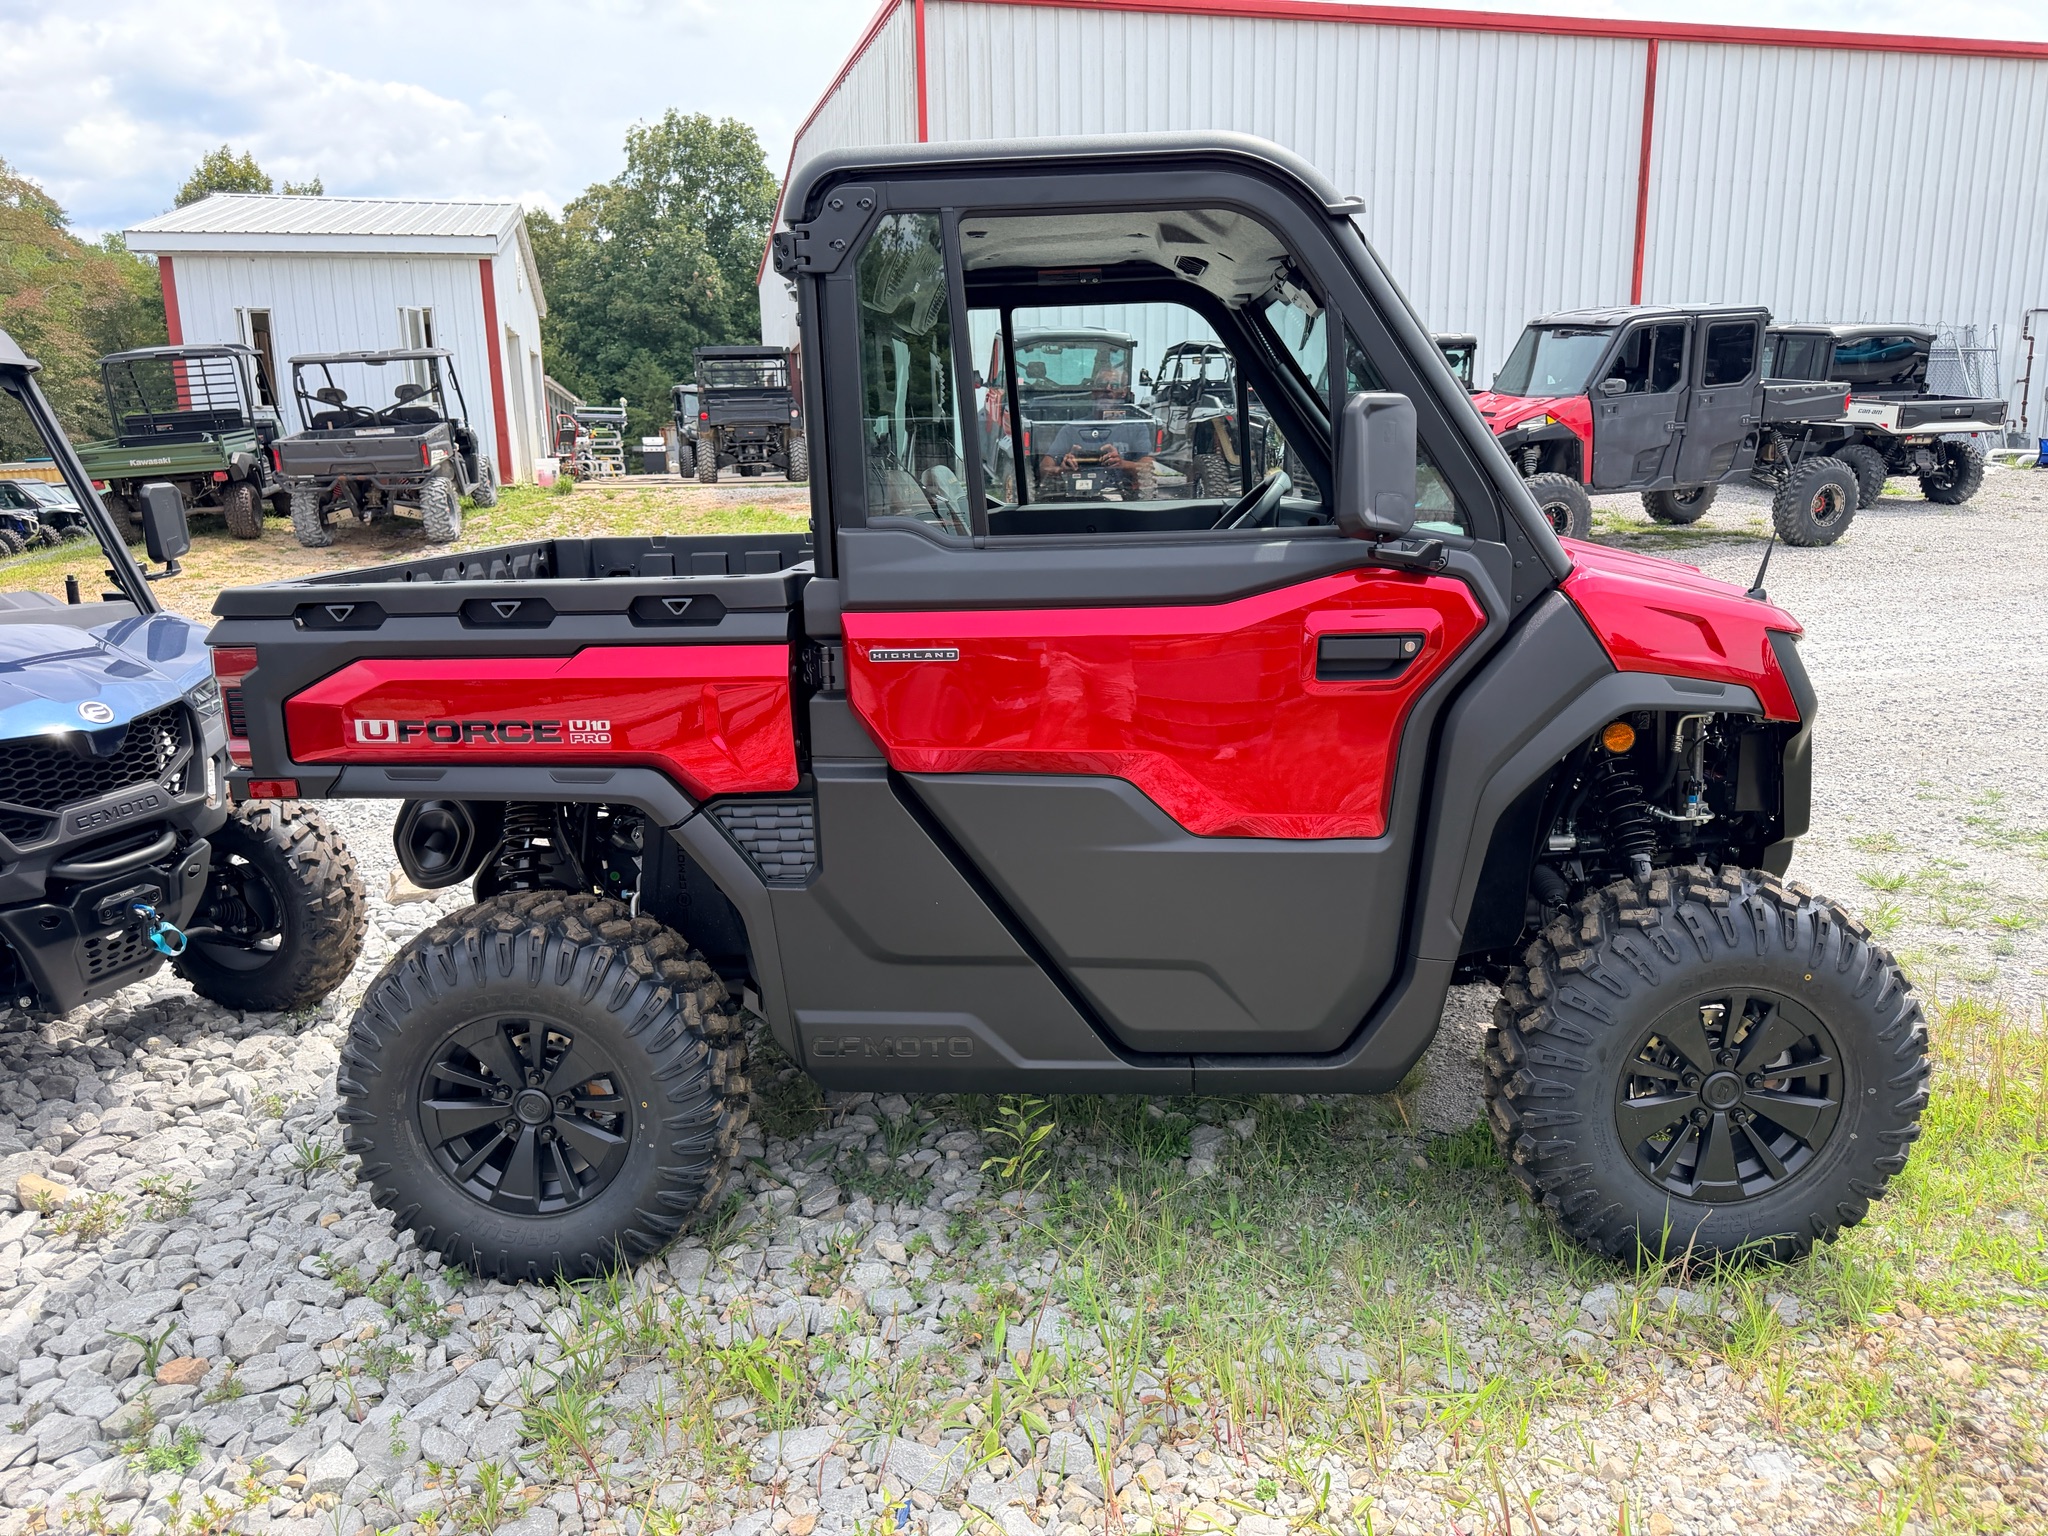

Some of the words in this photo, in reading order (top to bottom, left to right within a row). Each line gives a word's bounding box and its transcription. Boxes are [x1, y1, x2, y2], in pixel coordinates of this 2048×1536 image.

[129, 457, 171, 467] Kawasaki
[569, 720, 611, 732] U10
[570, 733, 612, 744] PRO
[75, 795, 159, 830] CFMOTO
[677, 843, 688, 889] CFMOT
[812, 1036, 974, 1058] CFMOTO
